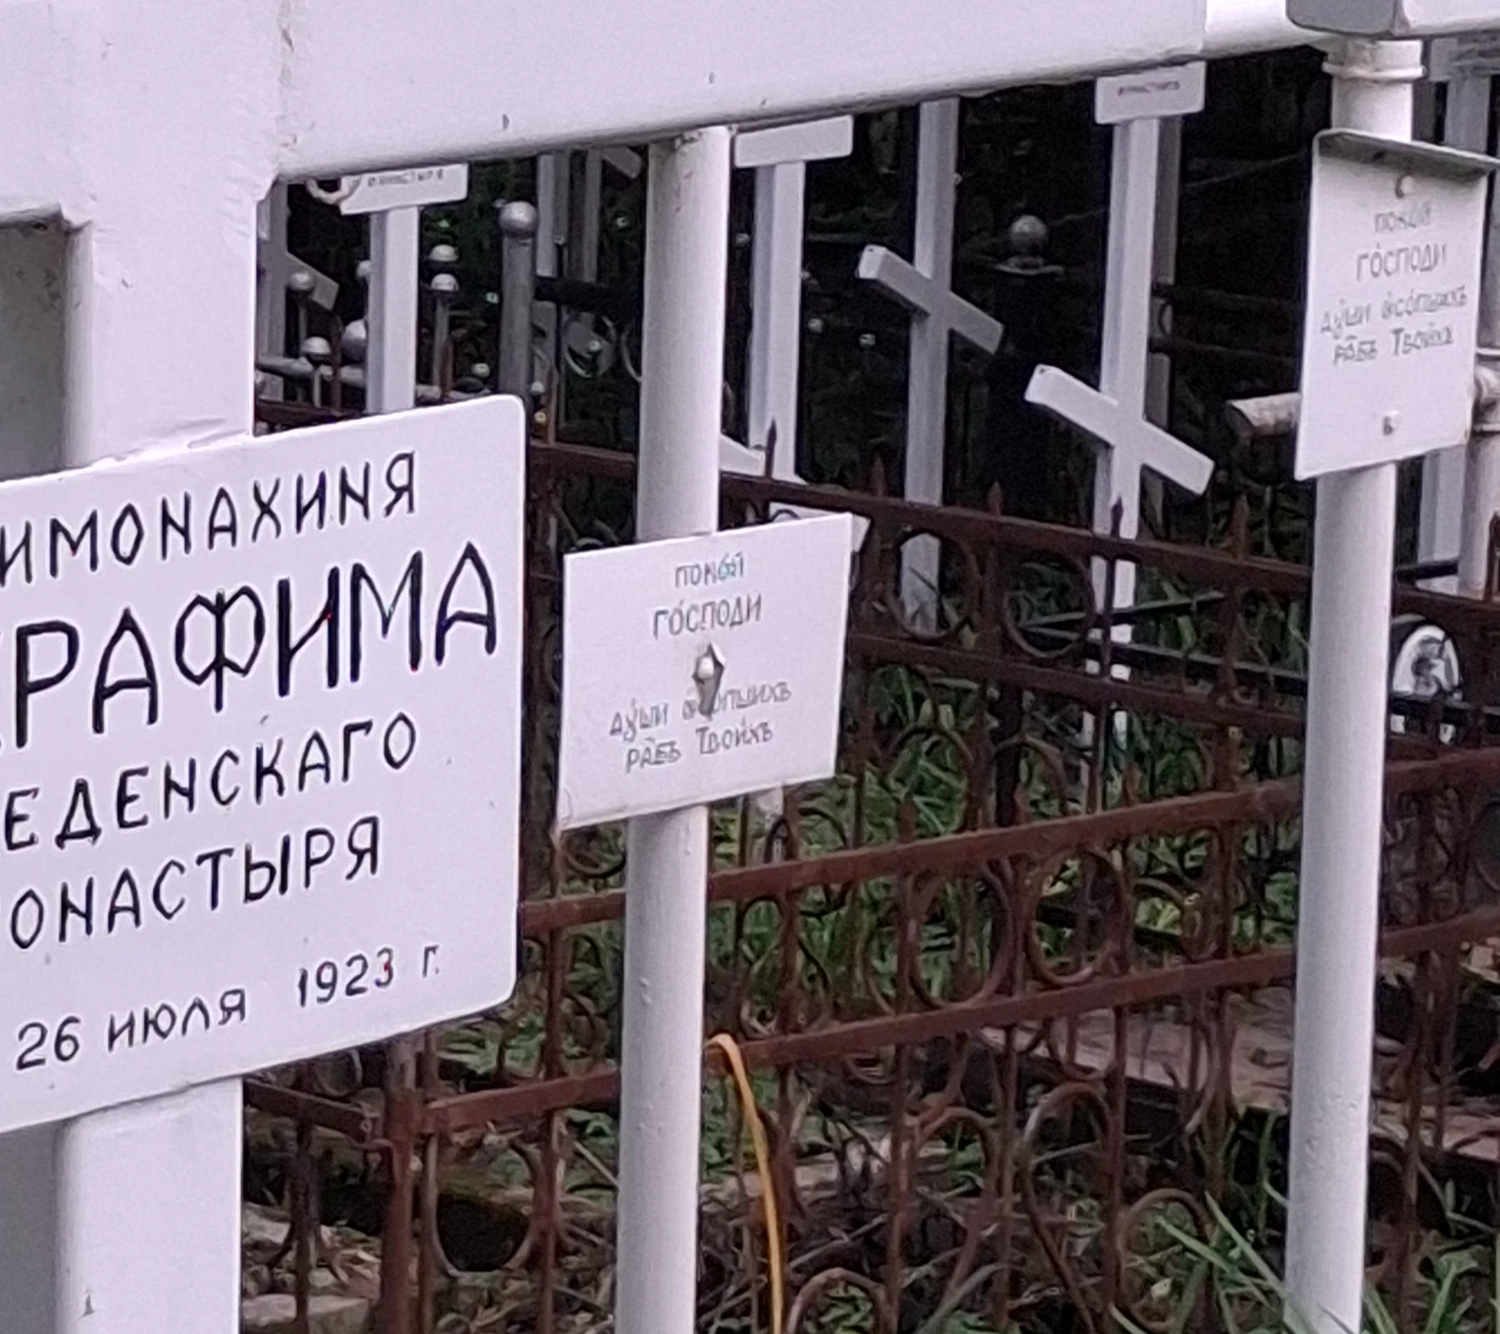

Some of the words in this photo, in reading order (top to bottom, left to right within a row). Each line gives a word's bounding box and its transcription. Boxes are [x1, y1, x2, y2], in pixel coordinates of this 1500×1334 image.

[15, 1015, 82, 1071] 26
[297, 947, 395, 1008] 1923
[421, 944, 442, 977] г.
